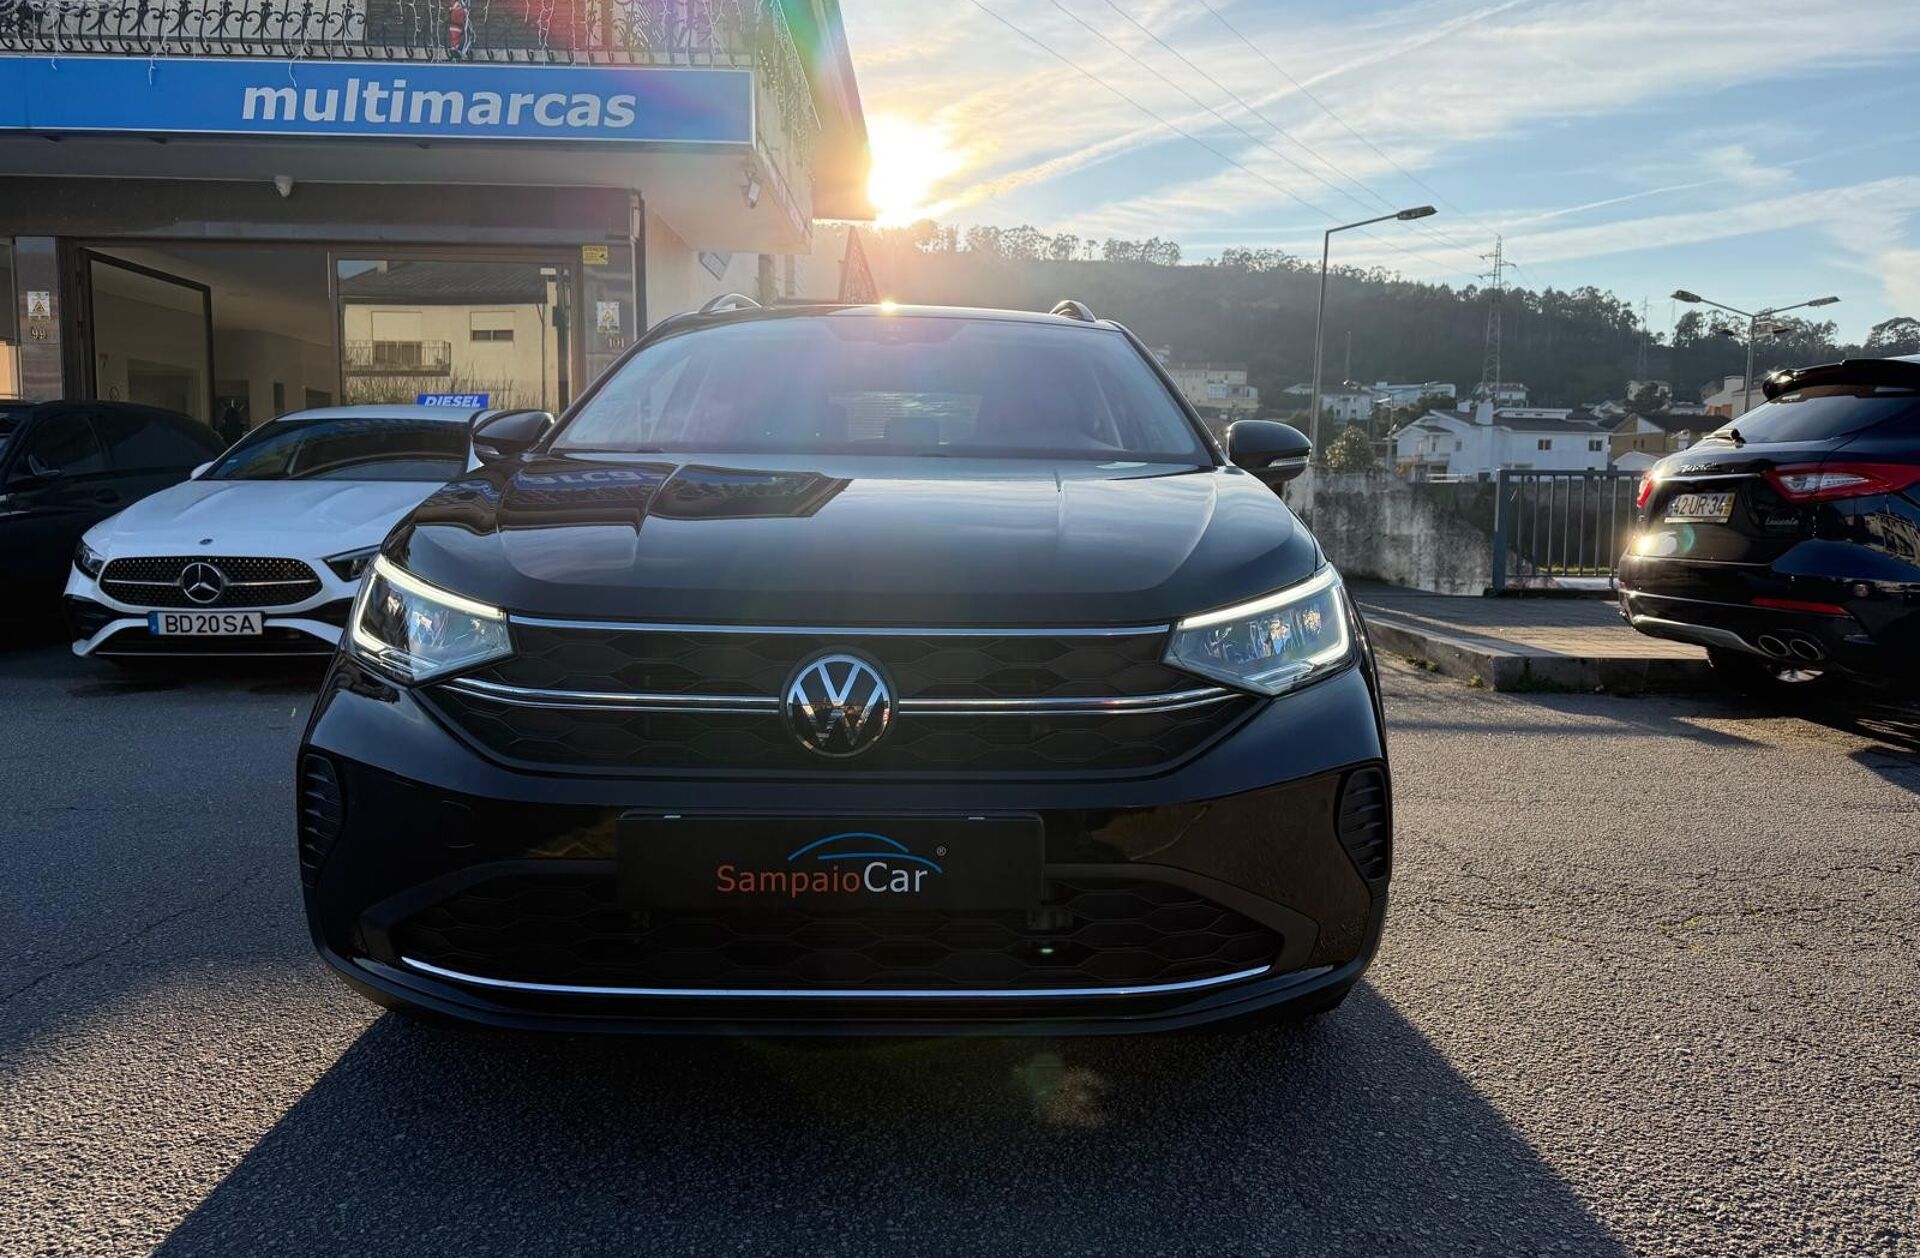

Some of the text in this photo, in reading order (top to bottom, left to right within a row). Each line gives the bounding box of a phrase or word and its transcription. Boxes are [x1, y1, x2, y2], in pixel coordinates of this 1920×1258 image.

[241, 78, 637, 129] multimarcas
[424, 395, 481, 408] DIESEL
[716, 861, 928, 898] SampaioCar
